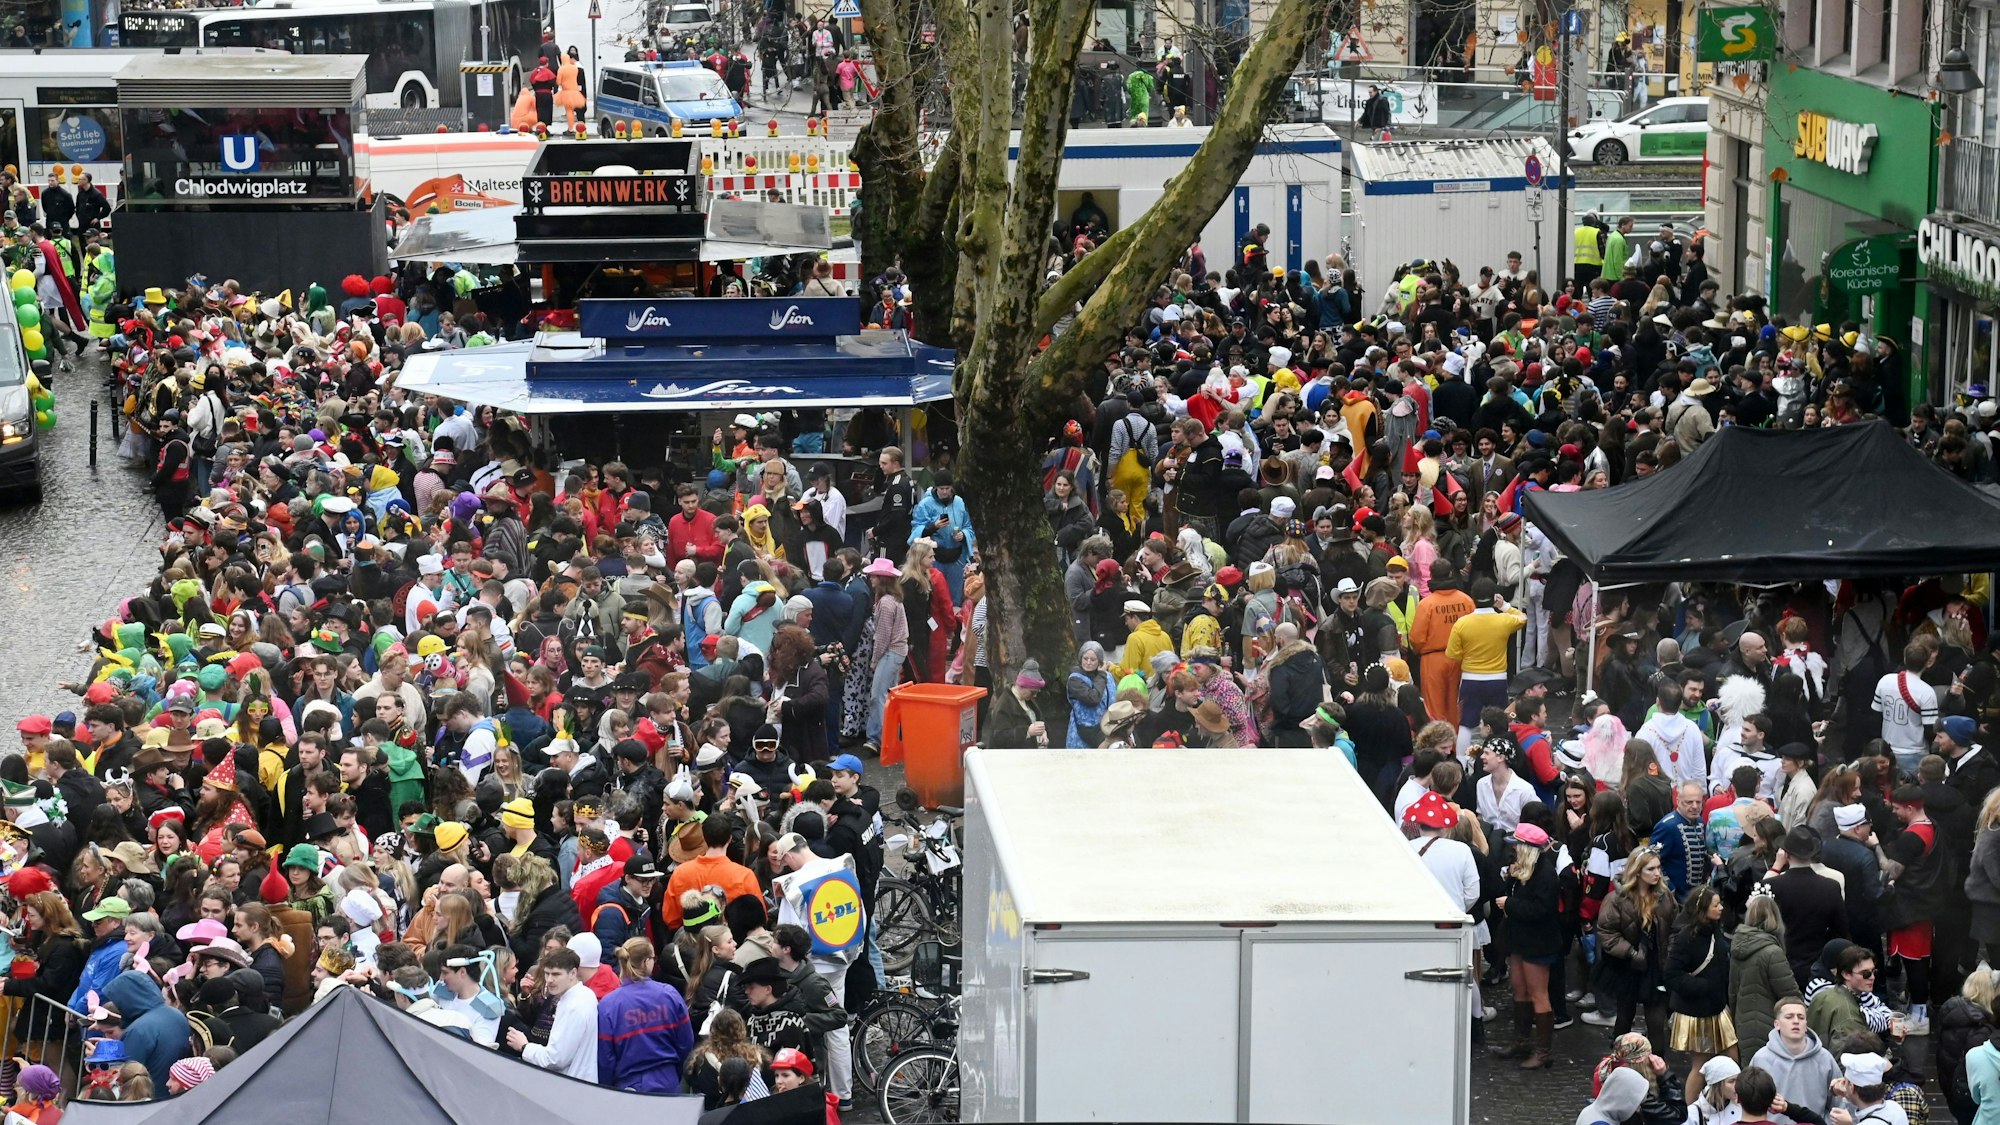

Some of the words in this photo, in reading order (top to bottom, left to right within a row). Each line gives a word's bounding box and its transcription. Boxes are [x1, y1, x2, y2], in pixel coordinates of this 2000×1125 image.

[60, 131, 82, 141] Seid
[83, 129, 100, 138] lieb
[61, 138, 101, 148] zueinander
[1794, 110, 1878, 176] SUBWAY
[175, 178, 307, 198] Chlodwigplatz
[550, 179, 669, 203] BRENNWERK
[455, 200, 482, 208] Boels
[1830, 262, 1900, 279] Koreanische
[1846, 277, 1882, 290] Küche
[625, 306, 672, 332] Sion
[768, 304, 814, 331] Sion
[640, 379, 804, 399] Sion
[1435, 603, 1466, 615] COUNTY
[1882, 694, 1909, 726] 60
[624, 1004, 669, 1027] Shell
